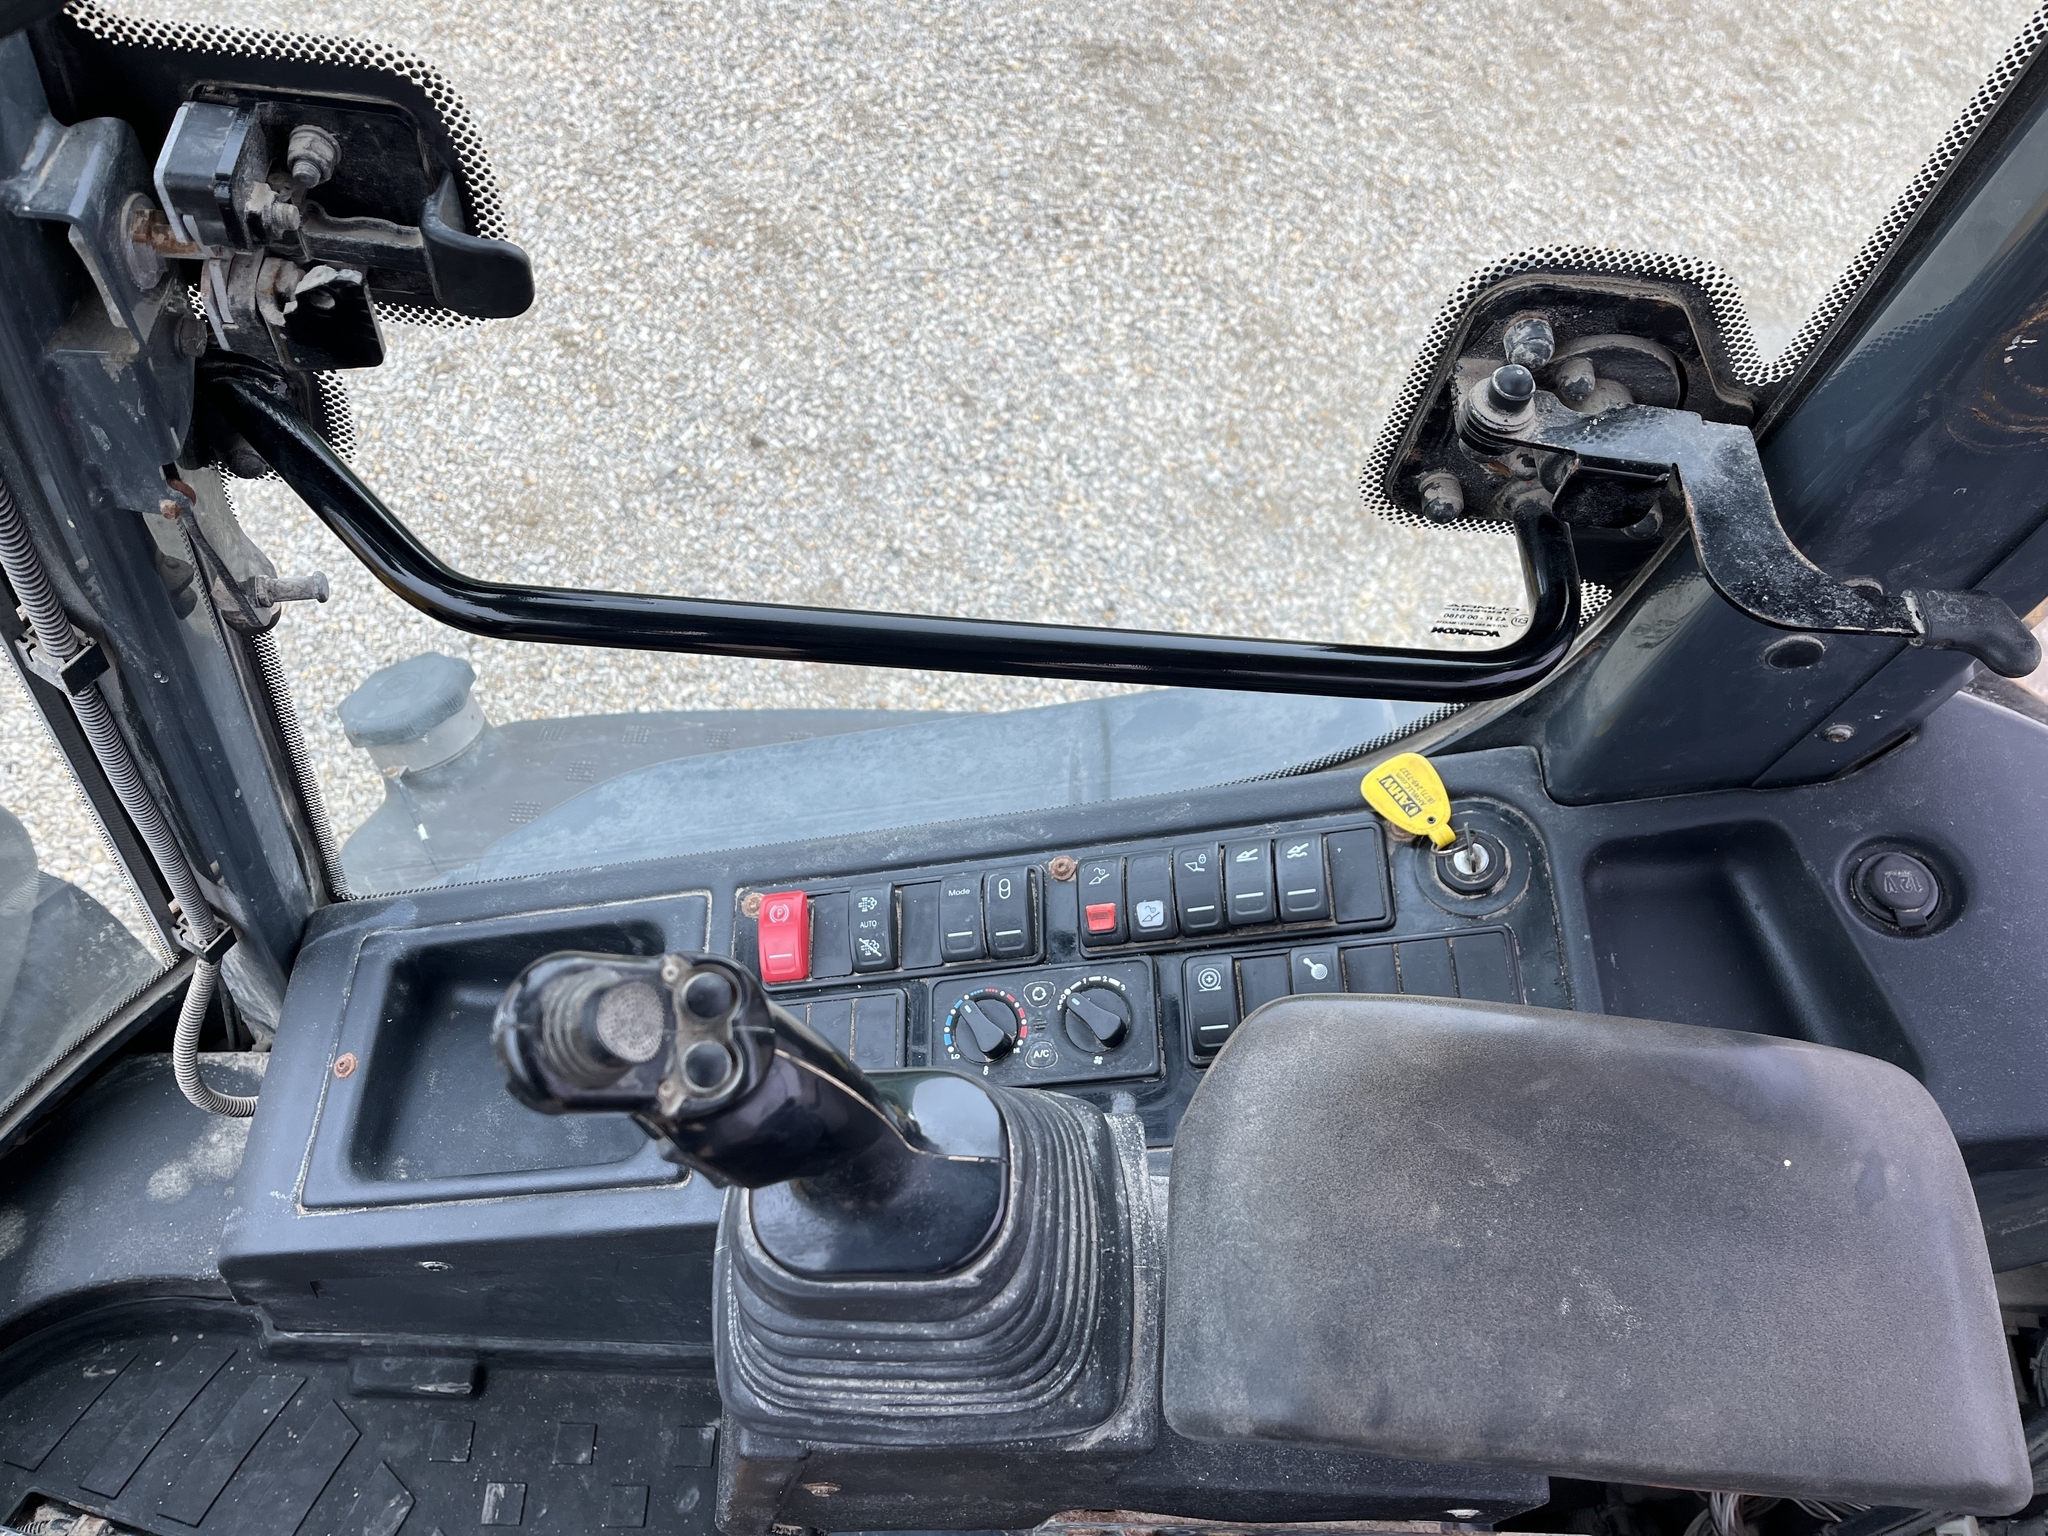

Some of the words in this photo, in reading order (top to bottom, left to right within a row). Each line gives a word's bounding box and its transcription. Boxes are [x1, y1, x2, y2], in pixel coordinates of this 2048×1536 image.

[1399, 767, 1423, 791] 249-7327
[1380, 777, 1413, 806] AHW
[1395, 773, 1426, 806] AHWLLC.com
[948, 887, 970, 896] Mode
[859, 919, 877, 929] AUTO
[1033, 1049, 1049, 1059] A/C
